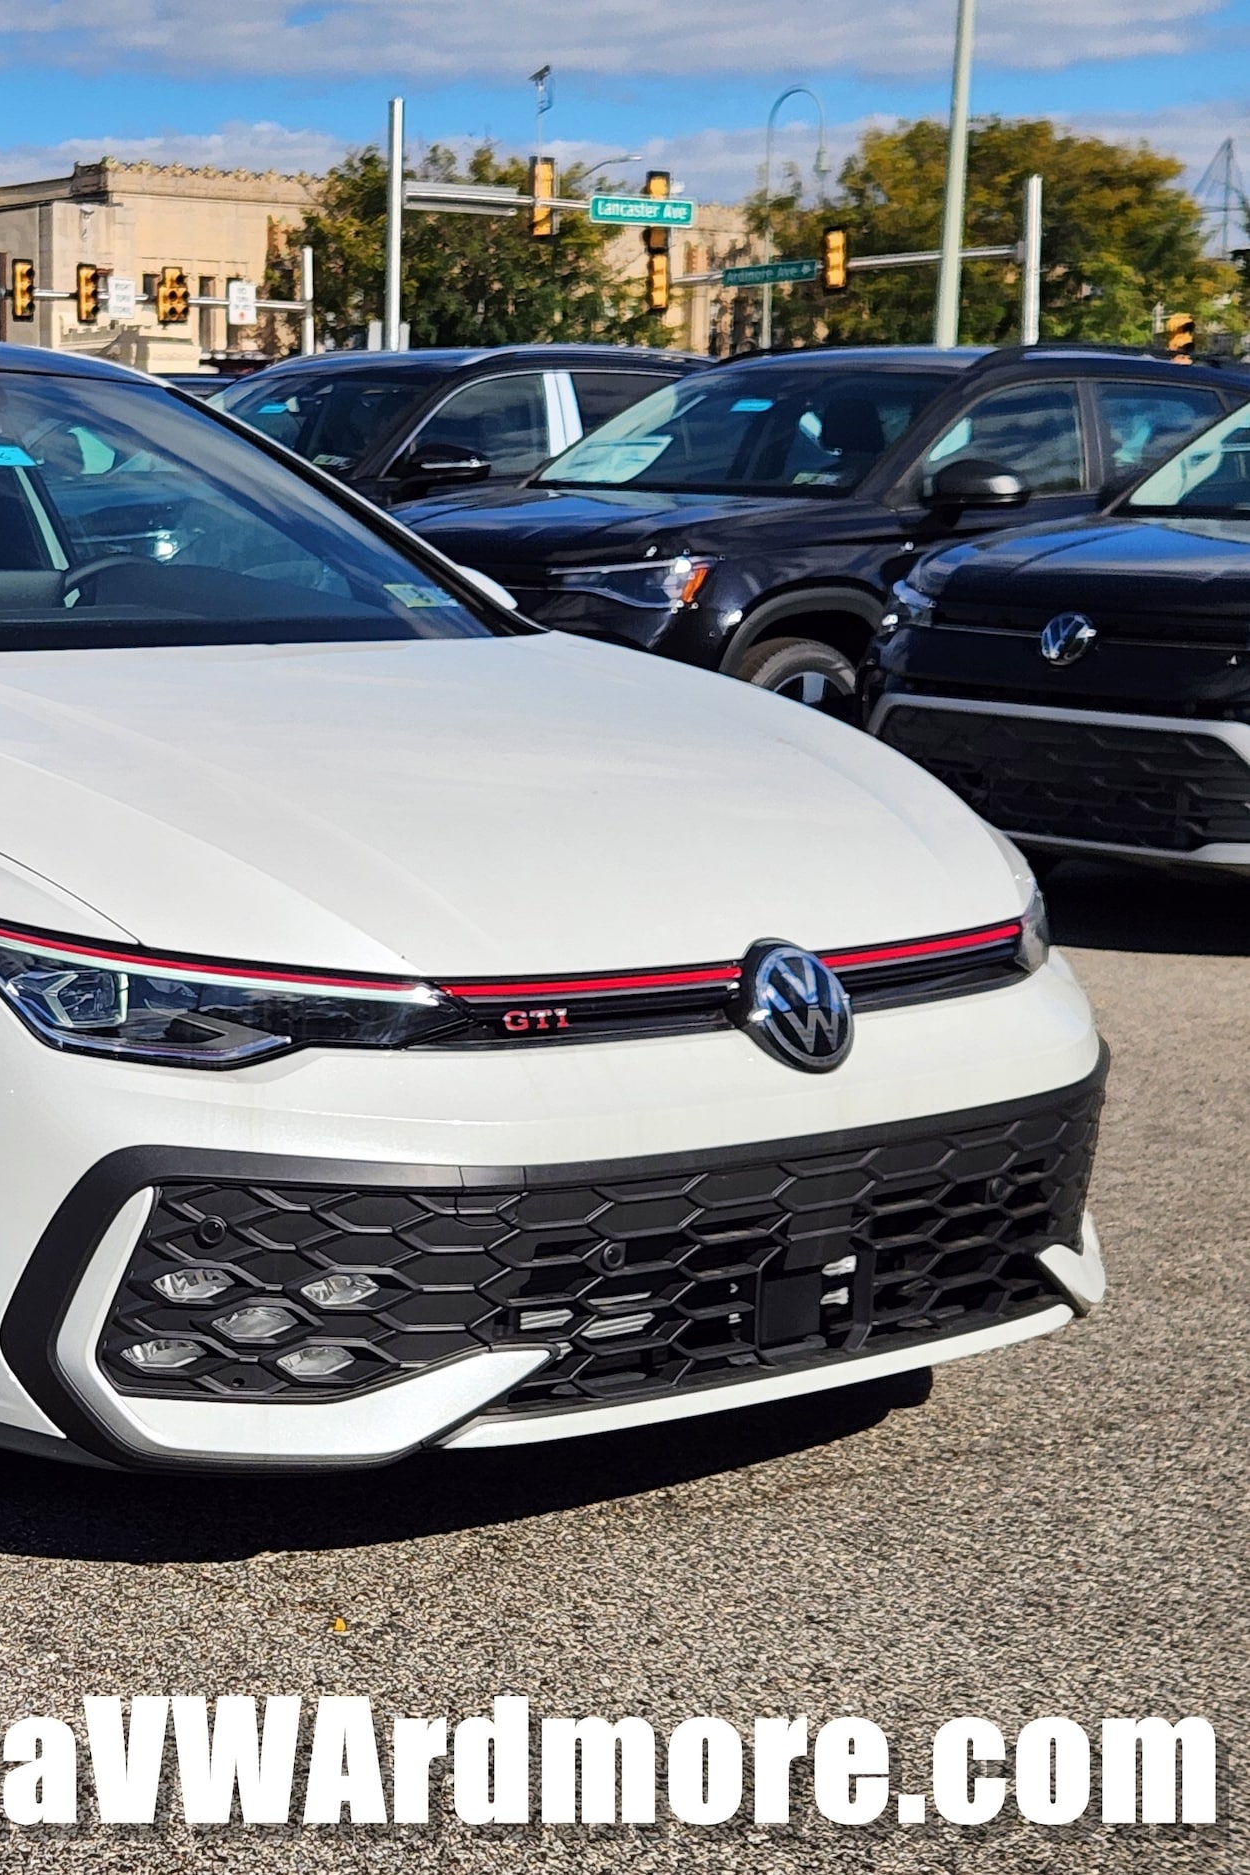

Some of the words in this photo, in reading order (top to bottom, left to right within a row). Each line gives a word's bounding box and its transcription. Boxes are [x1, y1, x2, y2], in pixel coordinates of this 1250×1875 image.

[597, 200, 661, 219] Lancaster
[663, 204, 688, 220] Ave
[727, 269, 774, 282] Ardmore
[777, 266, 798, 278] Ave
[502, 1008, 569, 1031] GTI
